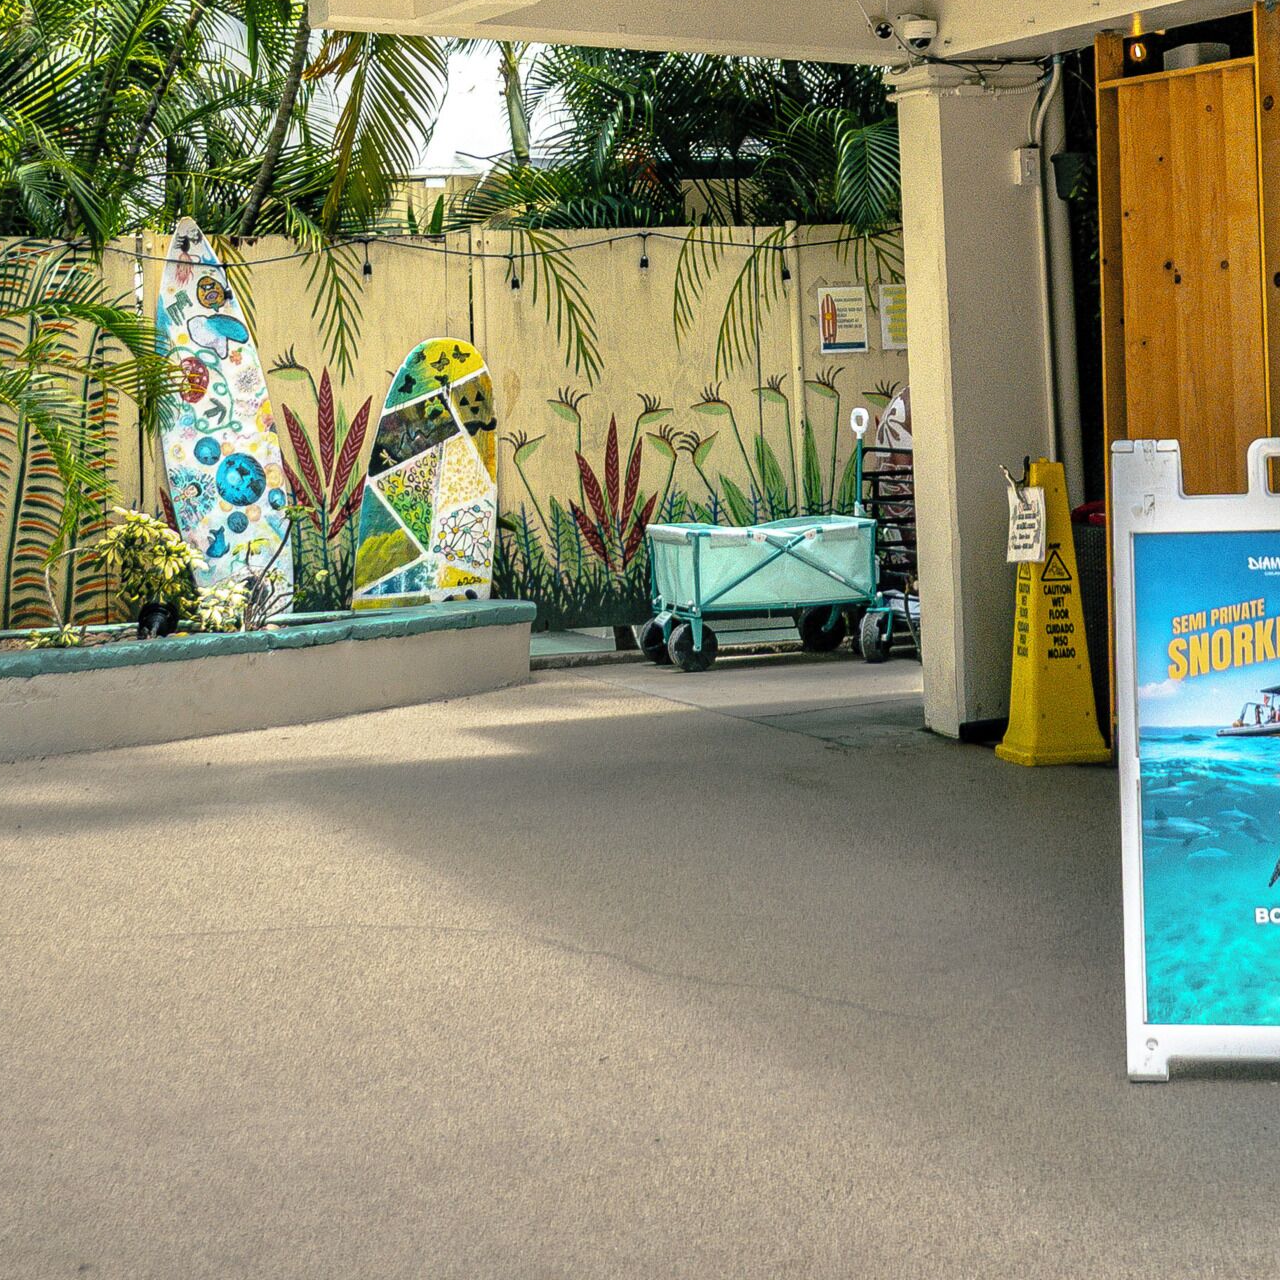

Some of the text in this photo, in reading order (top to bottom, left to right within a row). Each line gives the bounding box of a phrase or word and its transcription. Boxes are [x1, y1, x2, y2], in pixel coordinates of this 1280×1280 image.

[1043, 584, 1072, 595] CAUTION
[1052, 597, 1065, 607] WET
[1048, 609, 1070, 620] FLOOR
[1172, 598, 1265, 635] SEMI PRIVATE
[1046, 623, 1074, 634] CUIDADO
[1053, 636, 1068, 646] PISO
[1047, 648, 1076, 659] MOJADO
